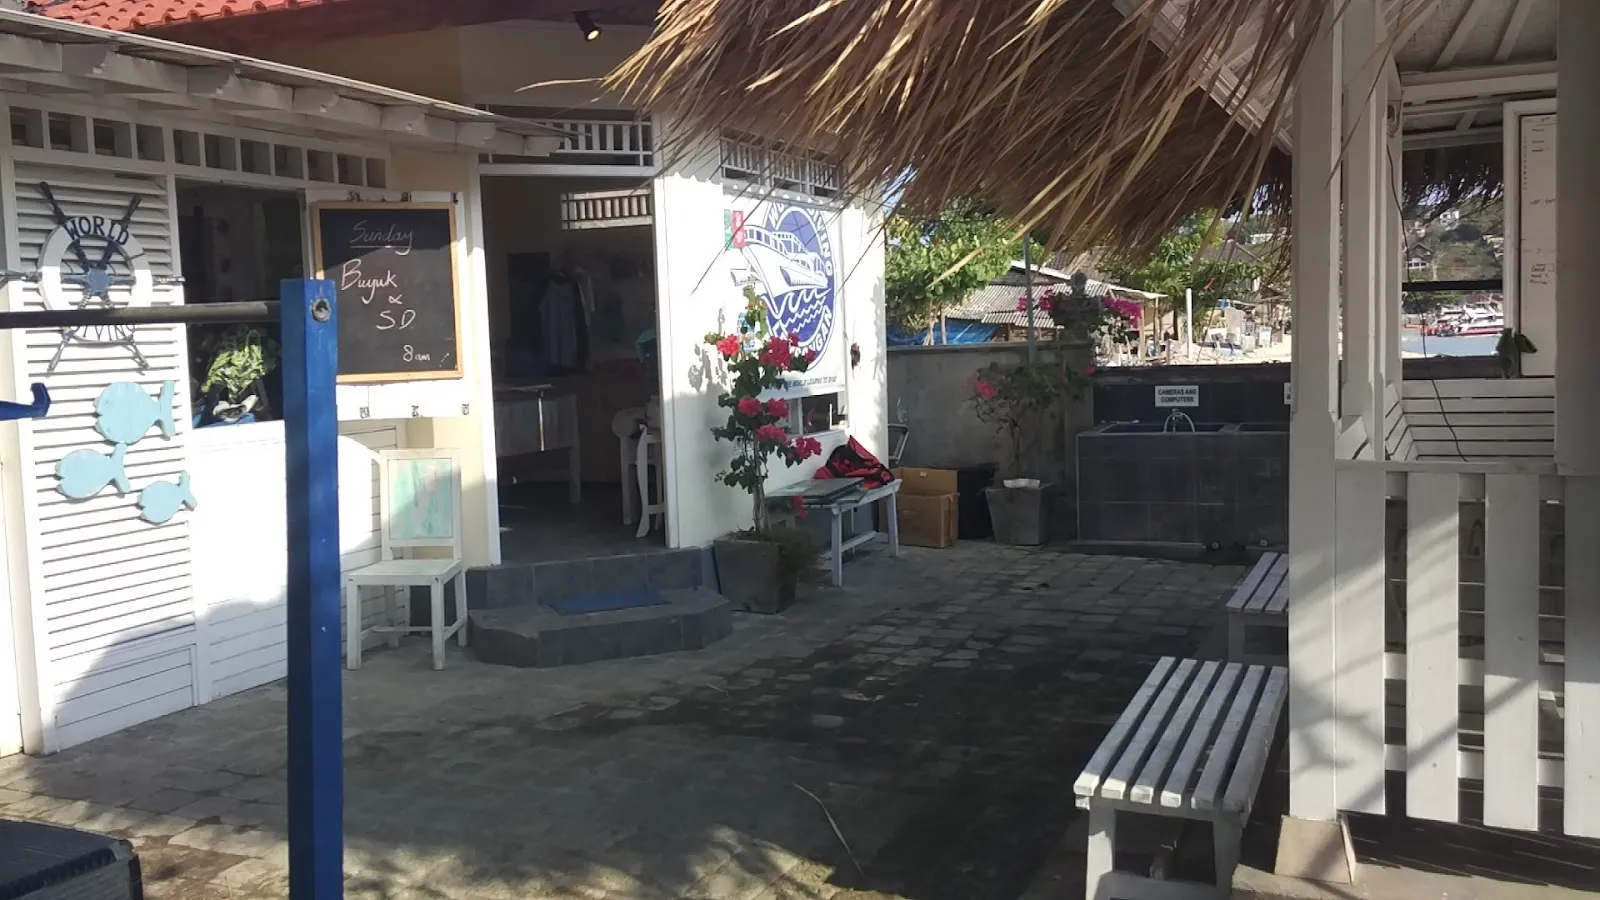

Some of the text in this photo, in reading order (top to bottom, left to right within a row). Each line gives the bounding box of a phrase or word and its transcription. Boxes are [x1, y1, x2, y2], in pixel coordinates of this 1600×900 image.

[63, 215, 130, 245] WORLD
[349, 219, 413, 255] Sunday
[1157, 388, 1185, 396] CAMERAS
